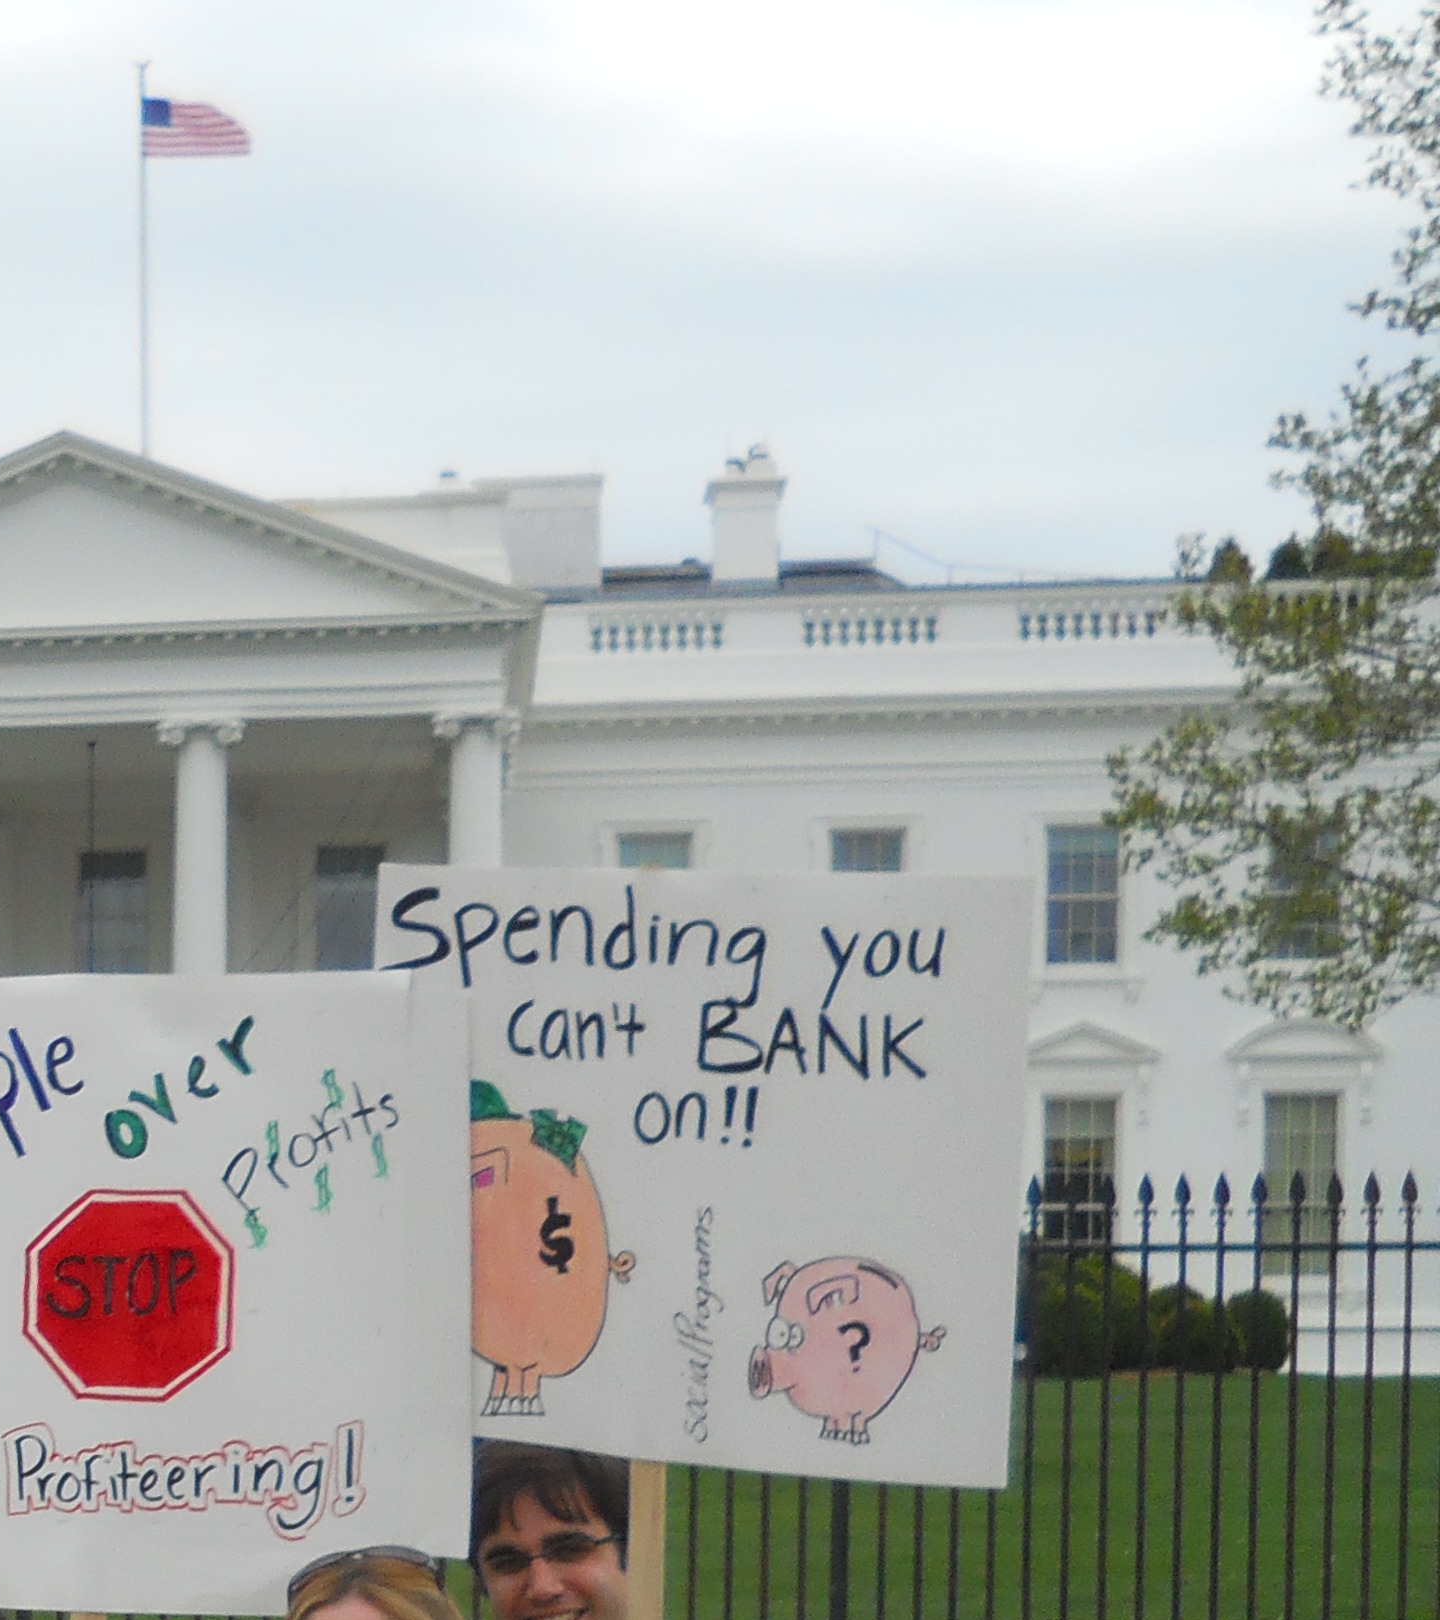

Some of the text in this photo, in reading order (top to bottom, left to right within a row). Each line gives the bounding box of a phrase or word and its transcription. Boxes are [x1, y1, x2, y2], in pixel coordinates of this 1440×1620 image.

[378, 885, 946, 1009] Spending you
[104, 1015, 255, 1160] over
[697, 997, 927, 1081] BANK
[633, 1085, 760, 1148] on!!
[44, 1247, 197, 1320] STOP
[2, 1419, 366, 1541] Profiteering!
